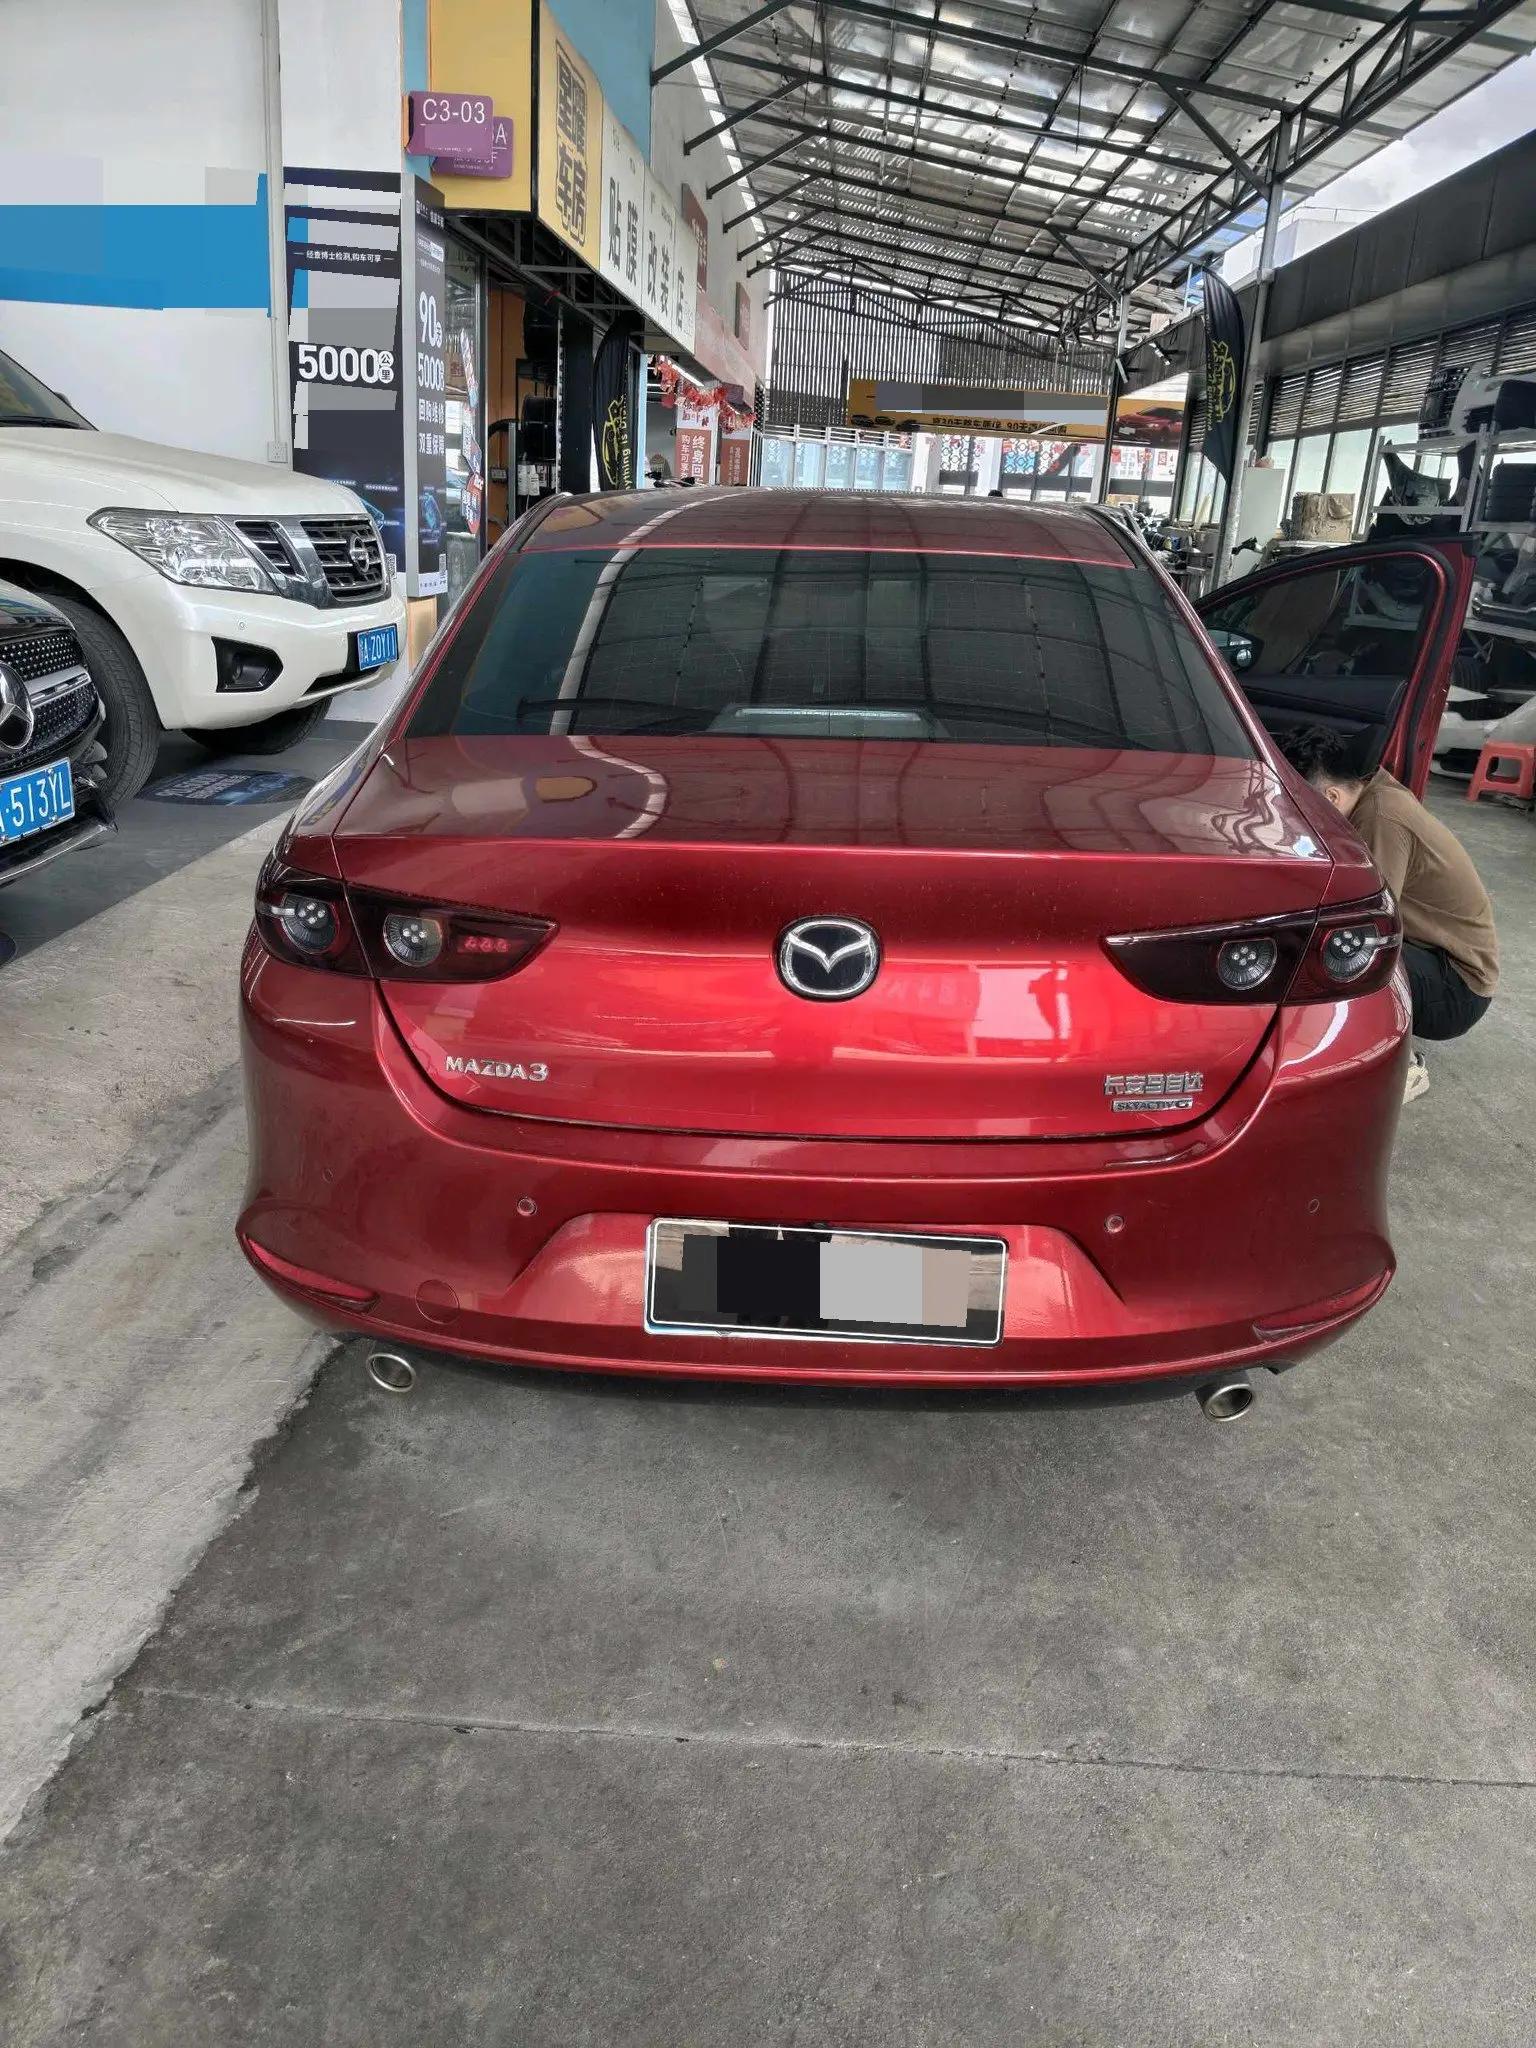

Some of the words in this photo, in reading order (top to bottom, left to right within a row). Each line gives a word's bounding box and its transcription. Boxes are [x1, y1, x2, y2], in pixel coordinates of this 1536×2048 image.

[423, 99, 485, 123] C3-03
[608, 176, 685, 331] 贴膜改装店
[692, 436, 705, 484] 终身回
[1104, 1072, 1204, 1095] 长安马自达
